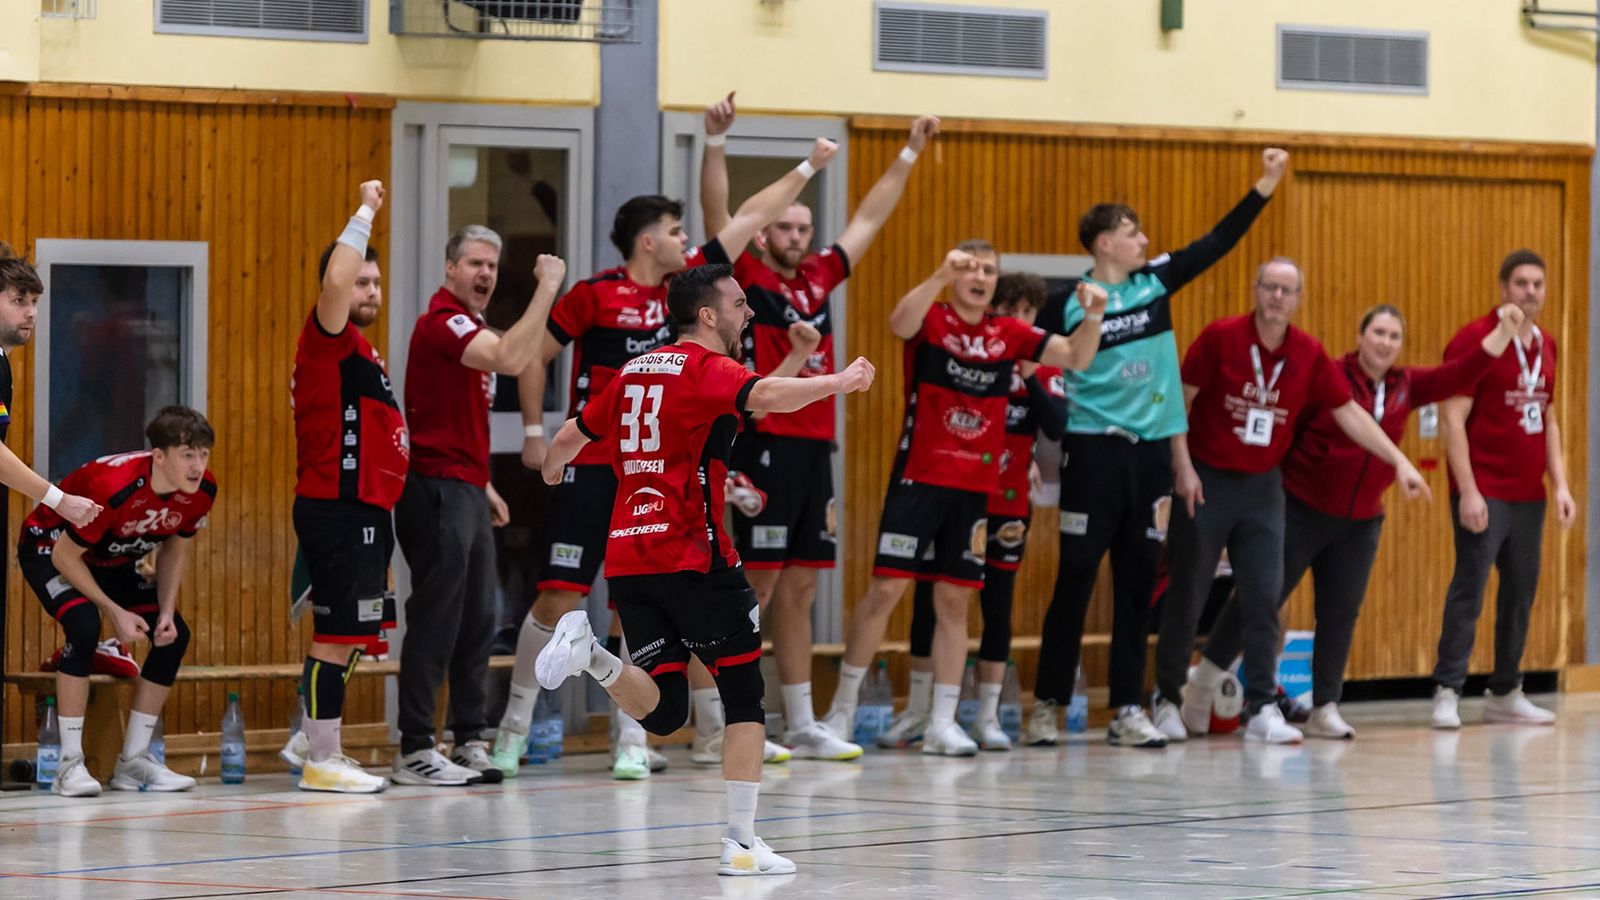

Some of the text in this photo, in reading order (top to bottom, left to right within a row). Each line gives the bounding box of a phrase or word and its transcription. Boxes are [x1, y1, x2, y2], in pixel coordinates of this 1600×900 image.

[665, 354, 686, 366] AG
[620, 384, 664, 453] 33
[1527, 406, 1538, 421] C
[1252, 417, 1267, 436] E
[362, 526, 376, 545] 17
[609, 523, 670, 538] SKECHERS
